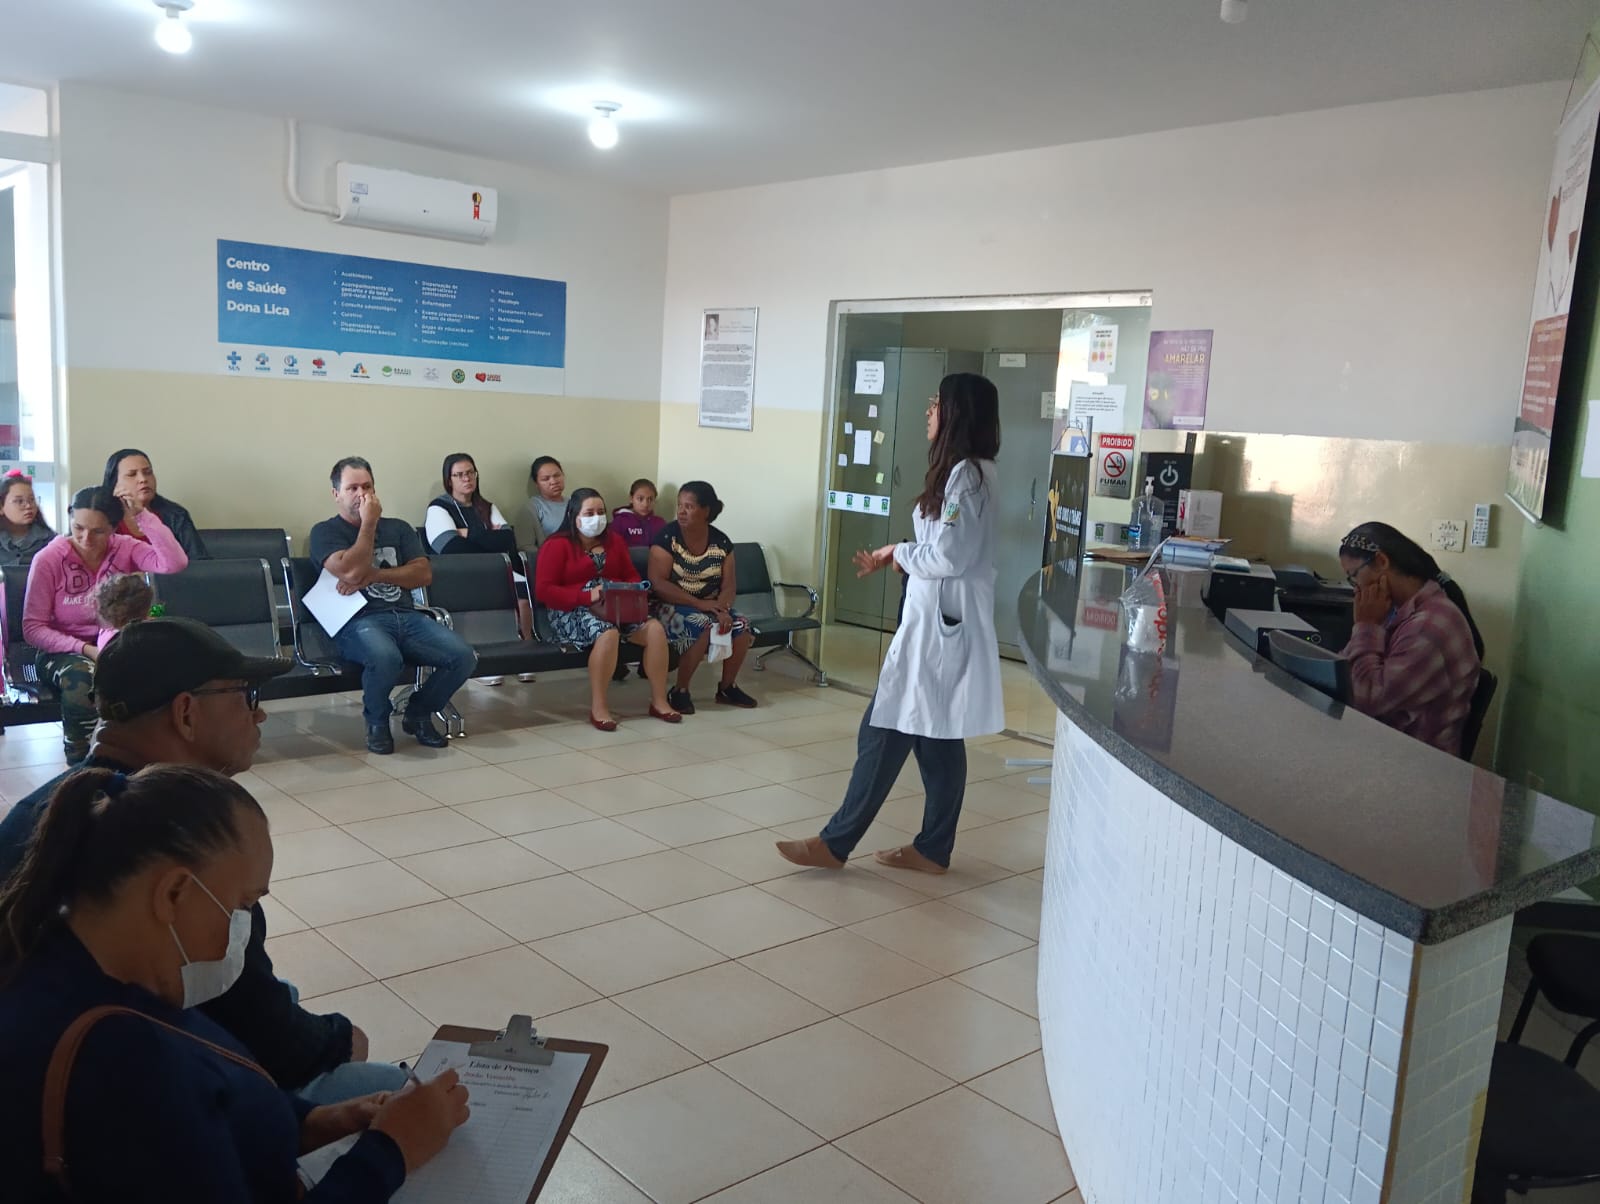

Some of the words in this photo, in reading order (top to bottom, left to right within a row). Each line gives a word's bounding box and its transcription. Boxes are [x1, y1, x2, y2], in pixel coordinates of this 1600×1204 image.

[226, 257, 270, 272] Centro
[226, 279, 243, 291] de
[247, 281, 287, 295] Saúde
[226, 300, 260, 313] Dona
[264, 303, 290, 316] Lica
[1164, 353, 1205, 364] AMARELAR
[1102, 437, 1133, 447] PROIBIDO
[1100, 478, 1127, 486] FUMAR
[63, 596, 82, 605] MAKE
[469, 1061, 490, 1069] Lista
[503, 1064, 540, 1074] Presença
